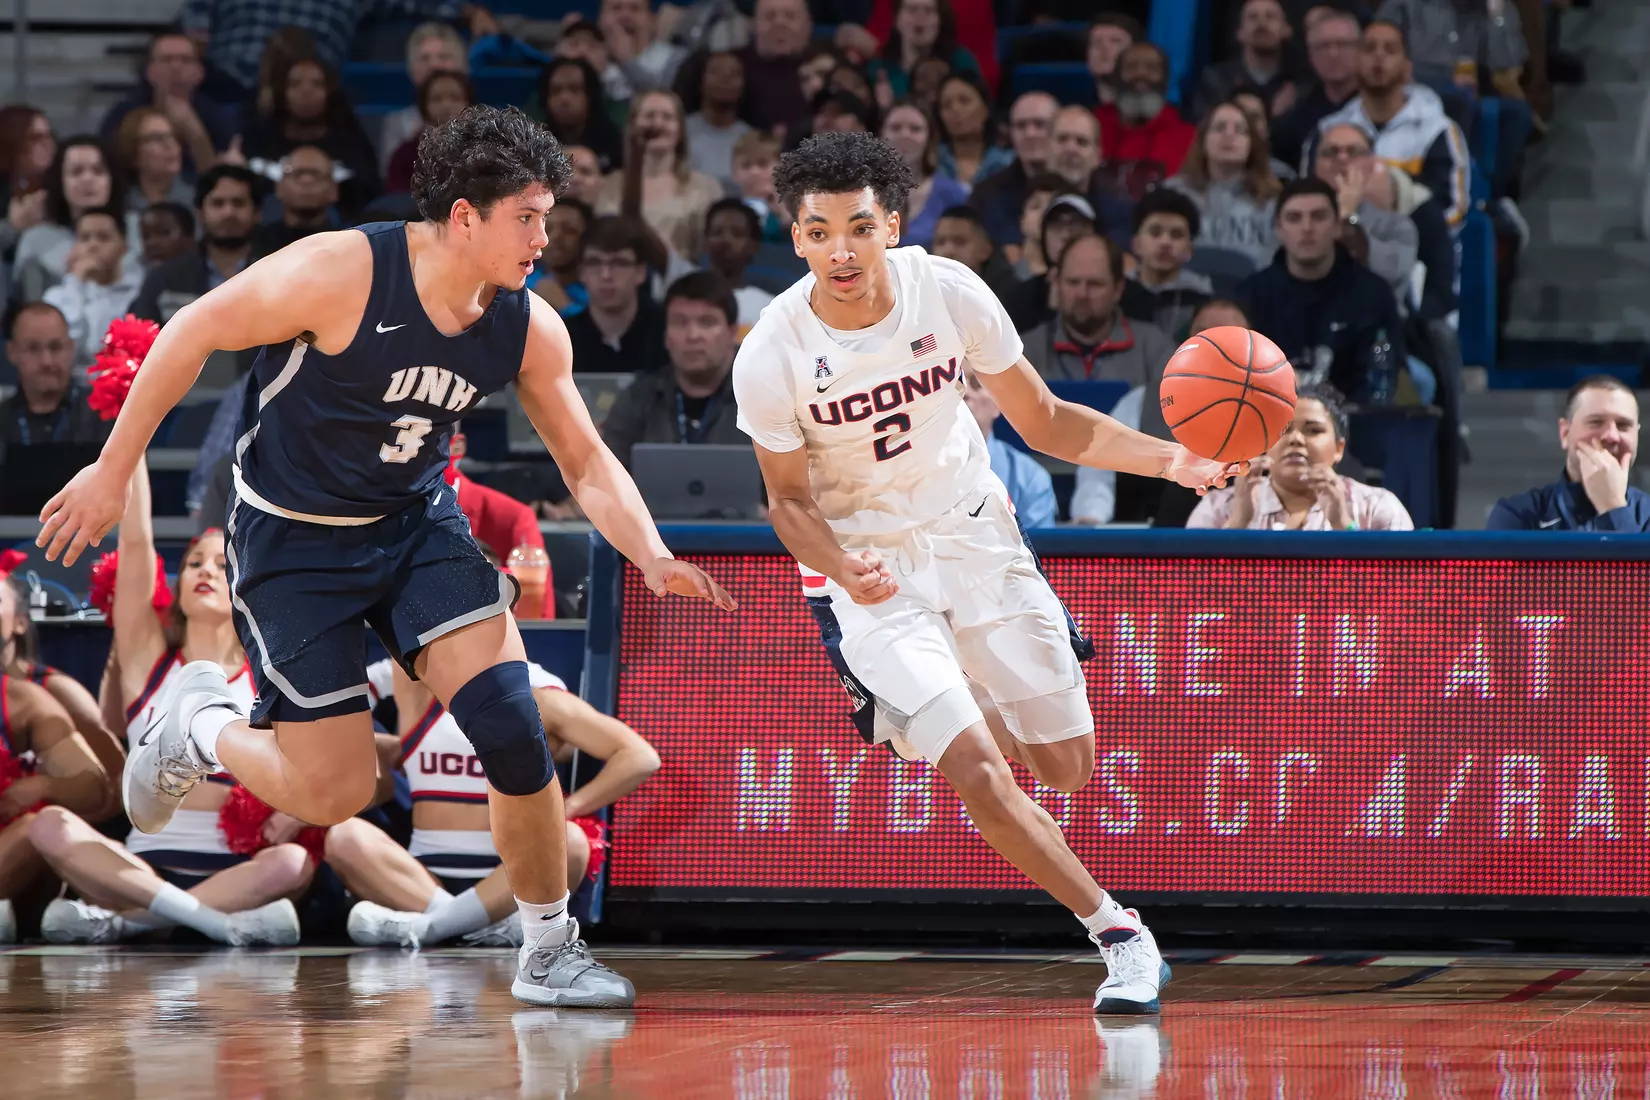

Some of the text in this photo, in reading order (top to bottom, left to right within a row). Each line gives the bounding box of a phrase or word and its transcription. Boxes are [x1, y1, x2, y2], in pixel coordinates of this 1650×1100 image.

[382, 366, 478, 412] UNH
[808, 357, 957, 426] UCONN
[379, 414, 433, 463] 3
[872, 412, 912, 462] 2
[1075, 611, 1227, 697] NE
